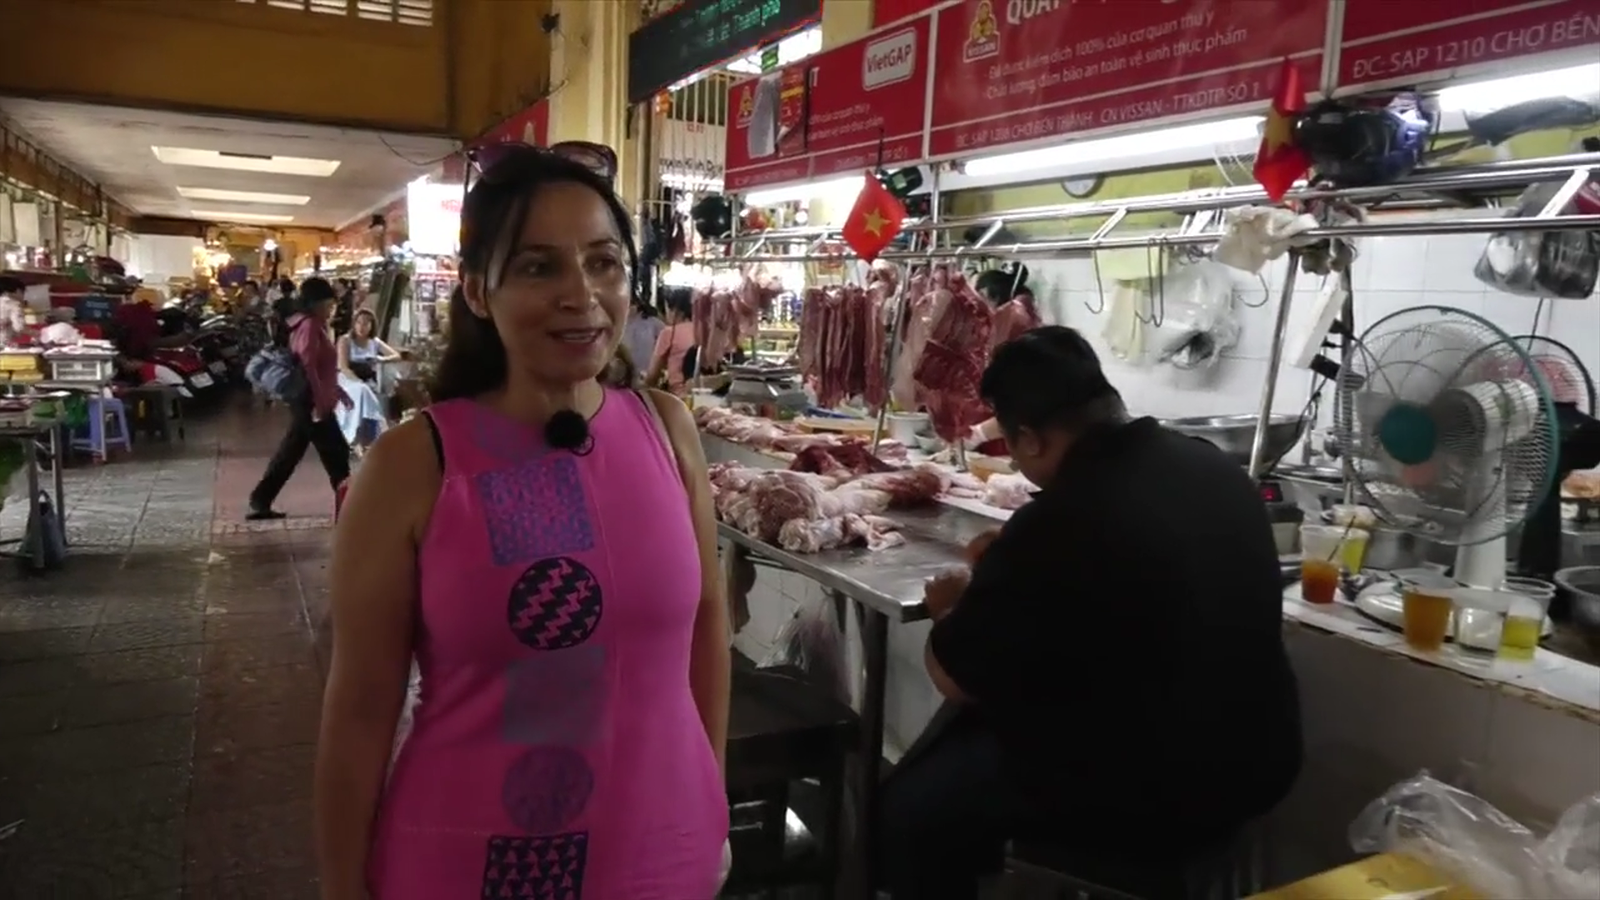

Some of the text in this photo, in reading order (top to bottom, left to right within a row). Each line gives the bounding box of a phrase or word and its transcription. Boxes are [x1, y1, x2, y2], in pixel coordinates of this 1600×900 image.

[867, 43, 912, 74] VietGAP
[1145, 44, 1170, 63] sinh
[1436, 36, 1486, 63] 1210
[1490, 23, 1547, 54] CHỢ
